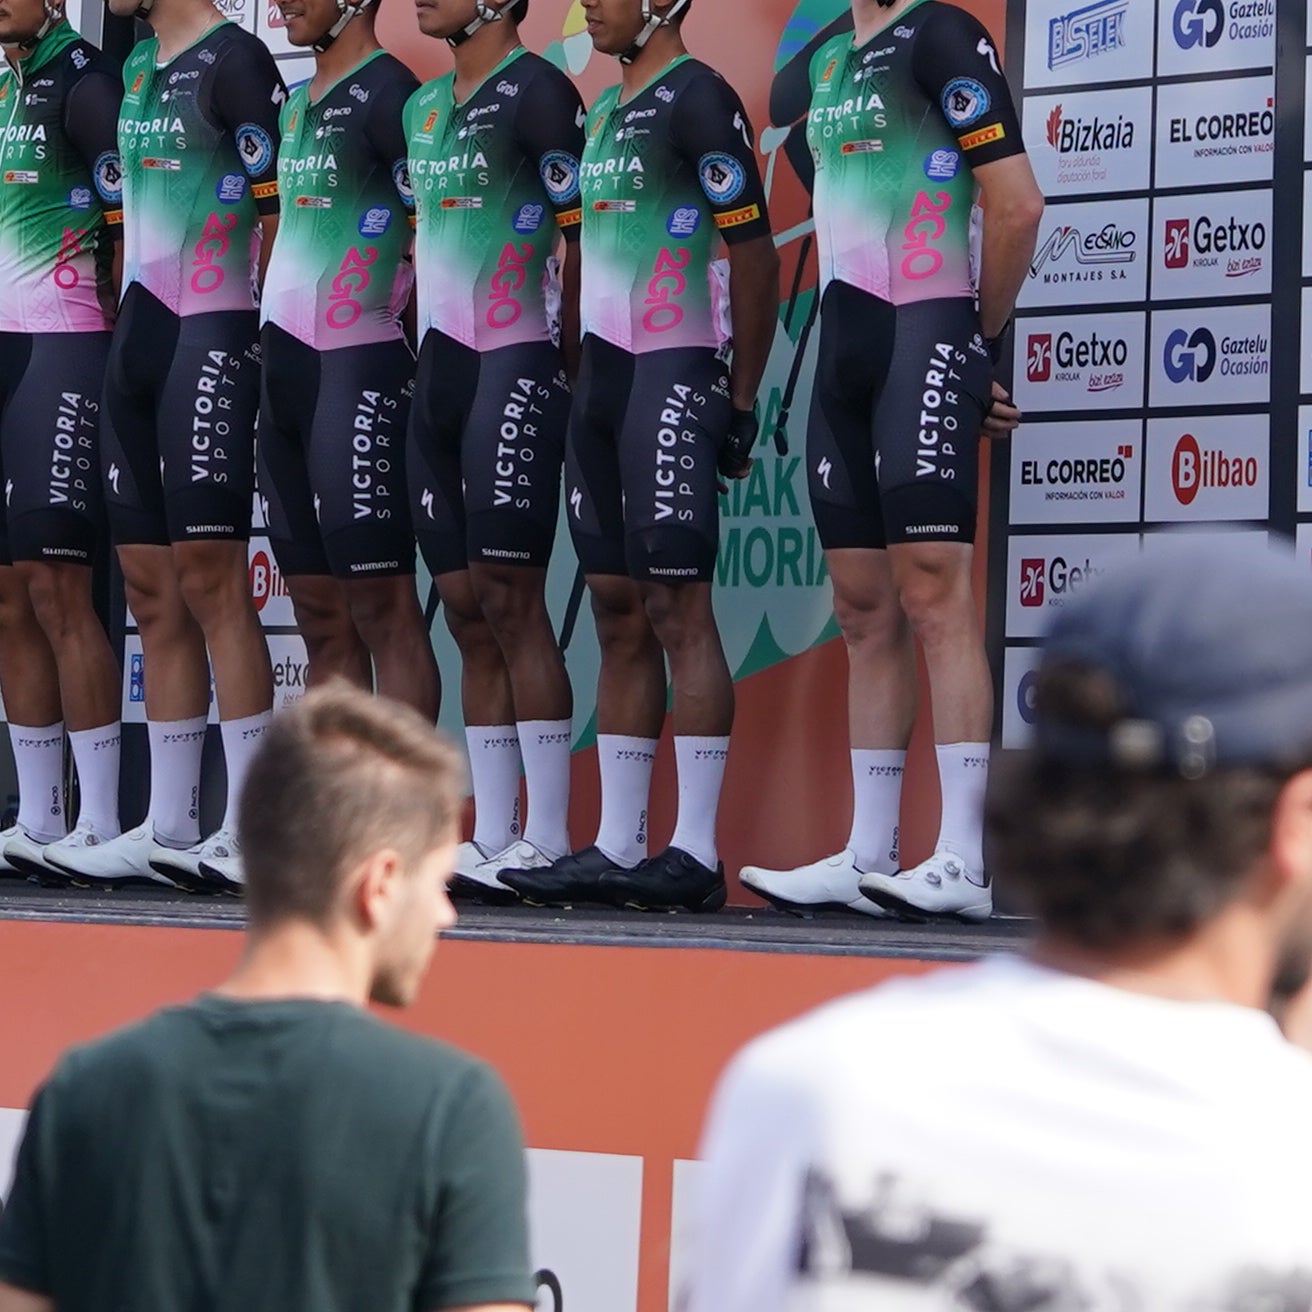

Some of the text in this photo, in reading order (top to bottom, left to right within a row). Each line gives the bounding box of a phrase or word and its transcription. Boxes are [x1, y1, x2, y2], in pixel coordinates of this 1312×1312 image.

[118, 117, 186, 135] ICTORIA
[808, 93, 885, 124] ICTORIA
[1170, 110, 1274, 143] EL CORREO
[1059, 115, 1135, 153] Bizkaia
[1238, 145, 1253, 155] CON
[278, 153, 338, 173] ICTORIA
[408, 152, 489, 175] ICTORIA
[579, 155, 645, 177] CTORIA
[191, 212, 238, 295] 2GO
[901, 190, 952, 280] 2GO
[1193, 216, 1266, 254] Getxo
[1043, 271, 1104, 284] MONTAJES
[1192, 257, 1219, 267] KIROLAK
[326, 246, 380, 330] 2GO
[486, 242, 535, 329] 2GO
[642, 247, 692, 334] 2GO
[1055, 331, 1128, 368] Getxo
[1220, 334, 1268, 356] Gaztelu
[1055, 372, 1081, 382] KIROLAK
[1220, 356, 1269, 377] Ocasión
[191, 348, 228, 483] VICTORIA
[213, 357, 242, 483] SPORTS
[916, 342, 954, 477] VICTORIA
[940, 351, 967, 480] SPORTS
[49, 391, 82, 505] VICTORIA
[73, 399, 99, 512] SPORTS
[352, 389, 381, 519] VICTORIA
[376, 397, 398, 519] SPORTS
[493, 376, 536, 507] VICTORIA
[516, 386, 550, 509] SPORTS
[654, 382, 692, 520] VICTORIA
[679, 392, 707, 522] SPORTS
[1021, 458, 1125, 485] EL CORREO
[1178, 450, 1257, 489] Bilbao
[1045, 490, 1125, 500] INFORMACIÓN CON VALOR
[186, 524, 234, 534] SHIMANO
[904, 523, 959, 534] SHIMANO
[42, 547, 87, 558] SHIMANO
[350, 560, 399, 573] SHIMANO
[481, 547, 531, 560] SHIMANO
[649, 566, 698, 576] SHIMANO
